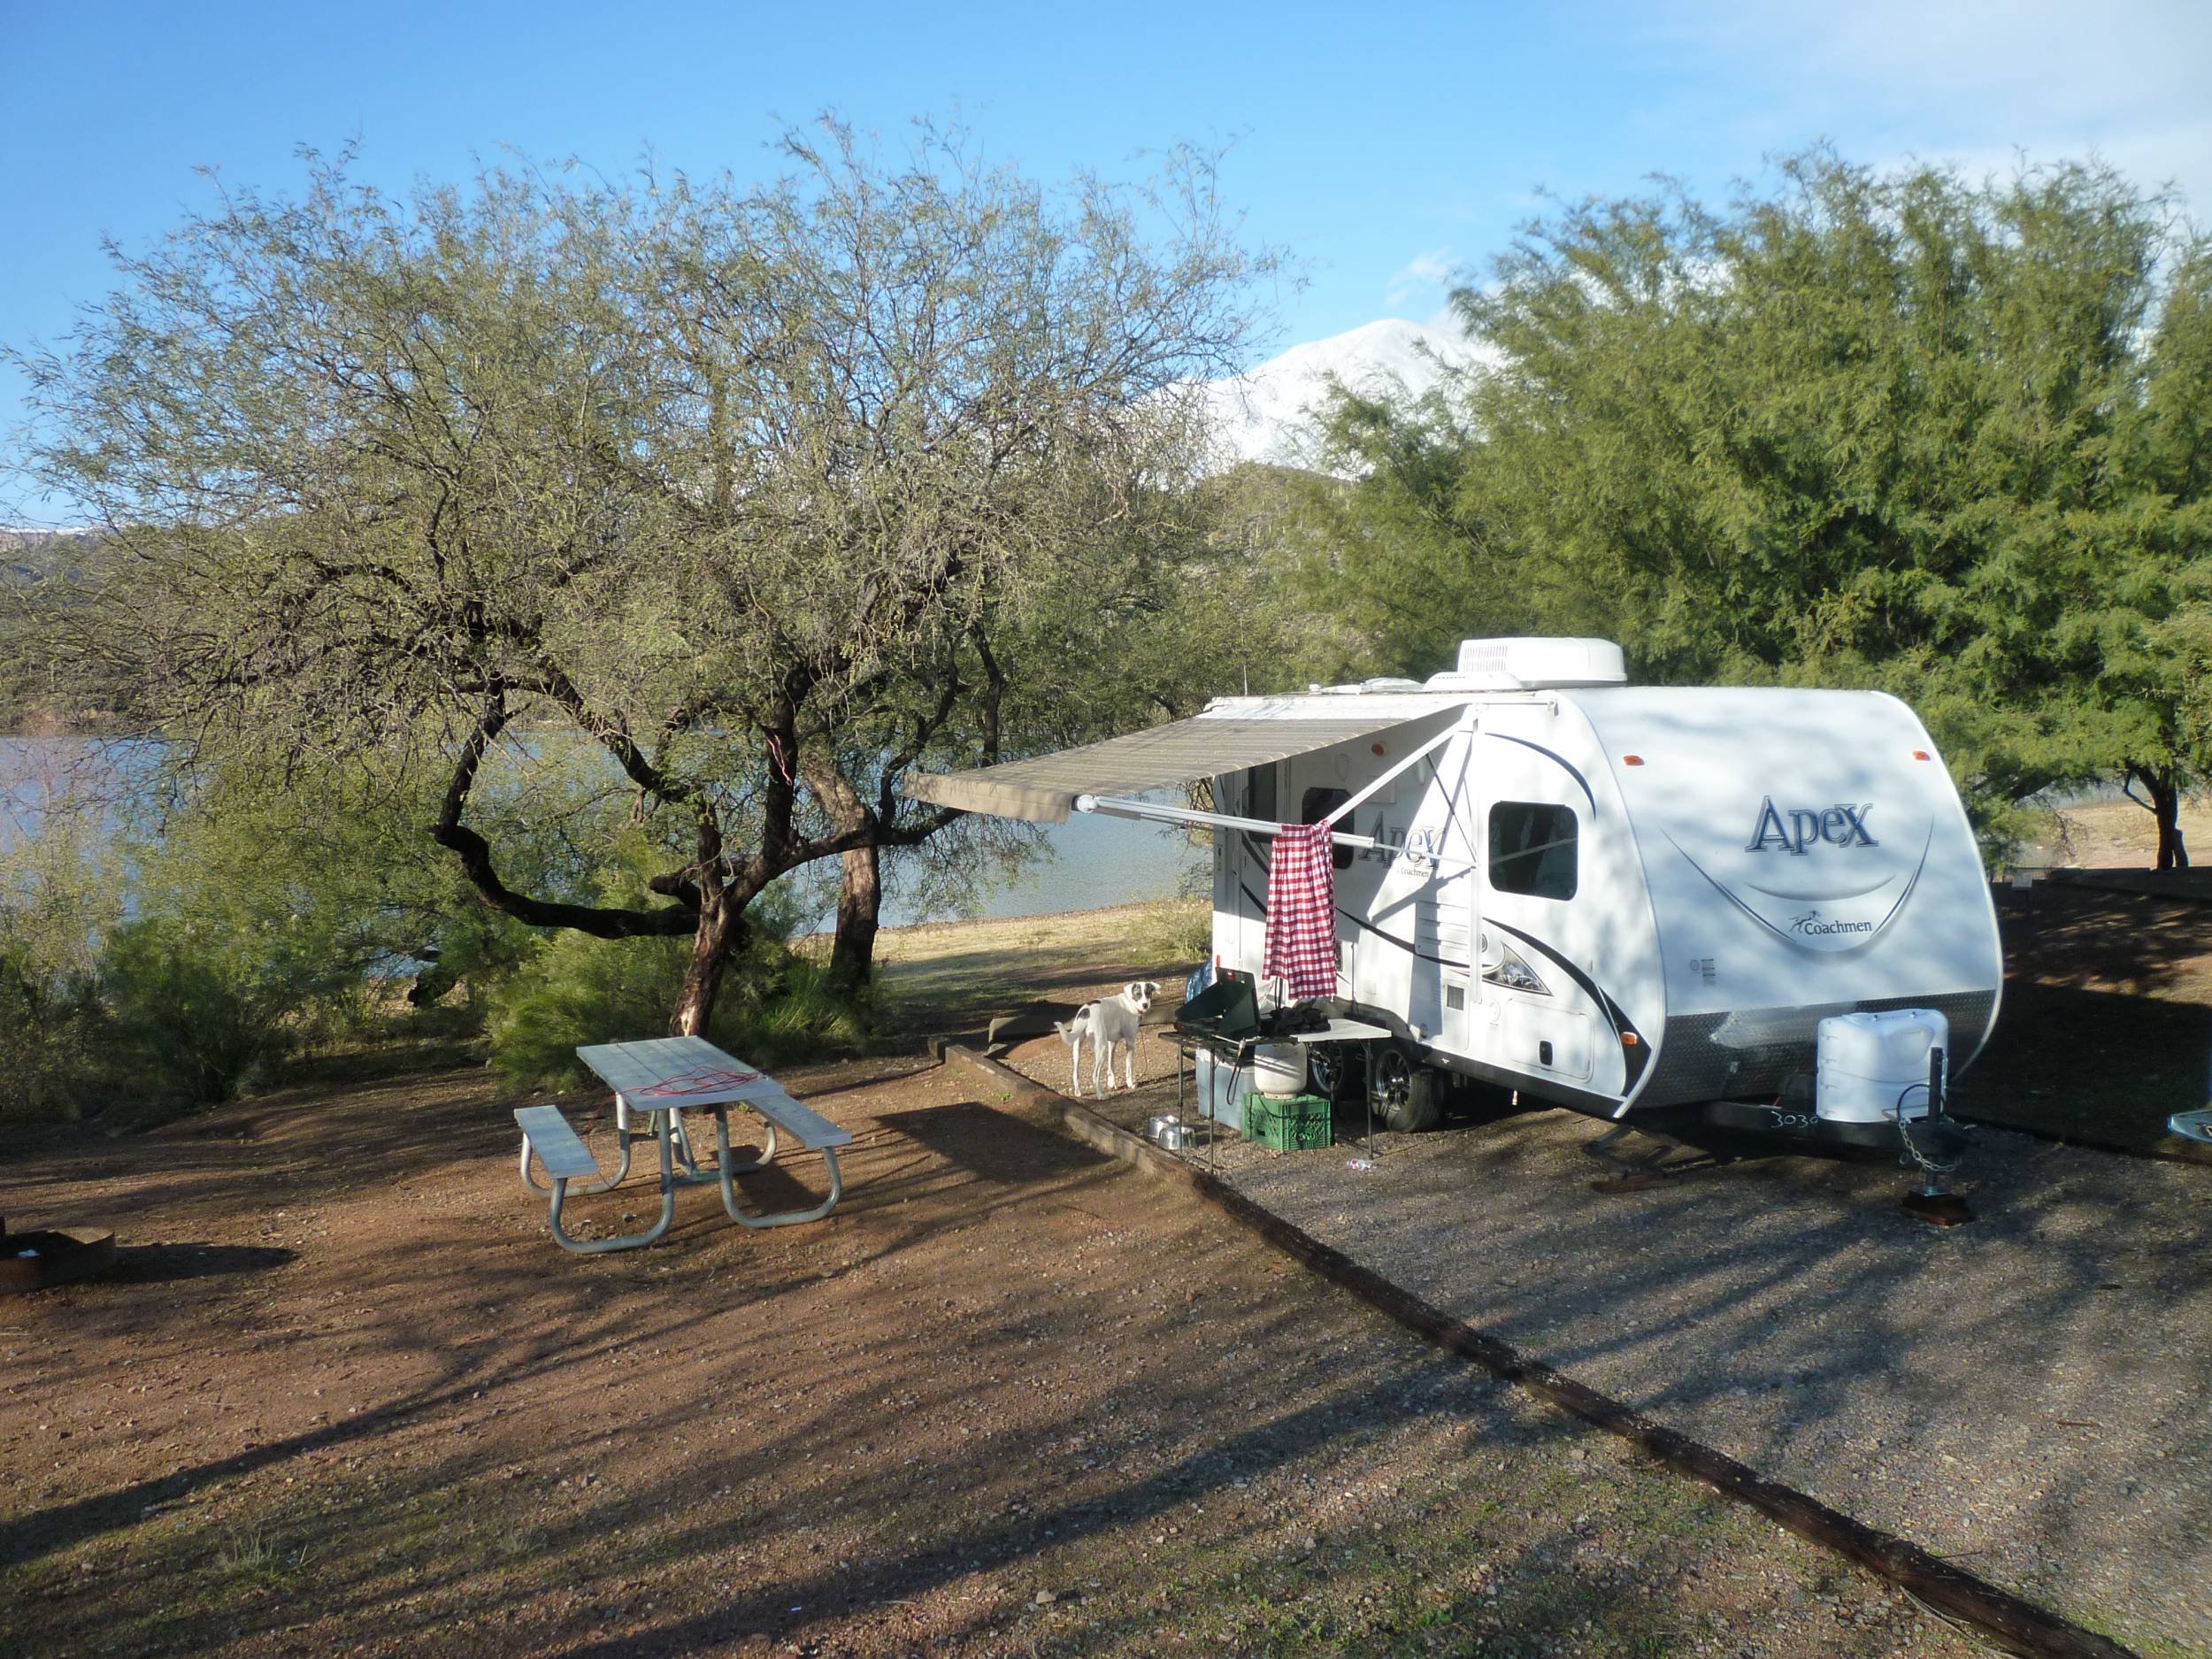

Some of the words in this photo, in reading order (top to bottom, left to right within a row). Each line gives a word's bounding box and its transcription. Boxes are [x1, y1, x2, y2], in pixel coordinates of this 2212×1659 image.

[1745, 795, 1879, 856] Apex
[1401, 867, 1430, 879] Coachmen
[1804, 920, 1873, 935] Coachmen
